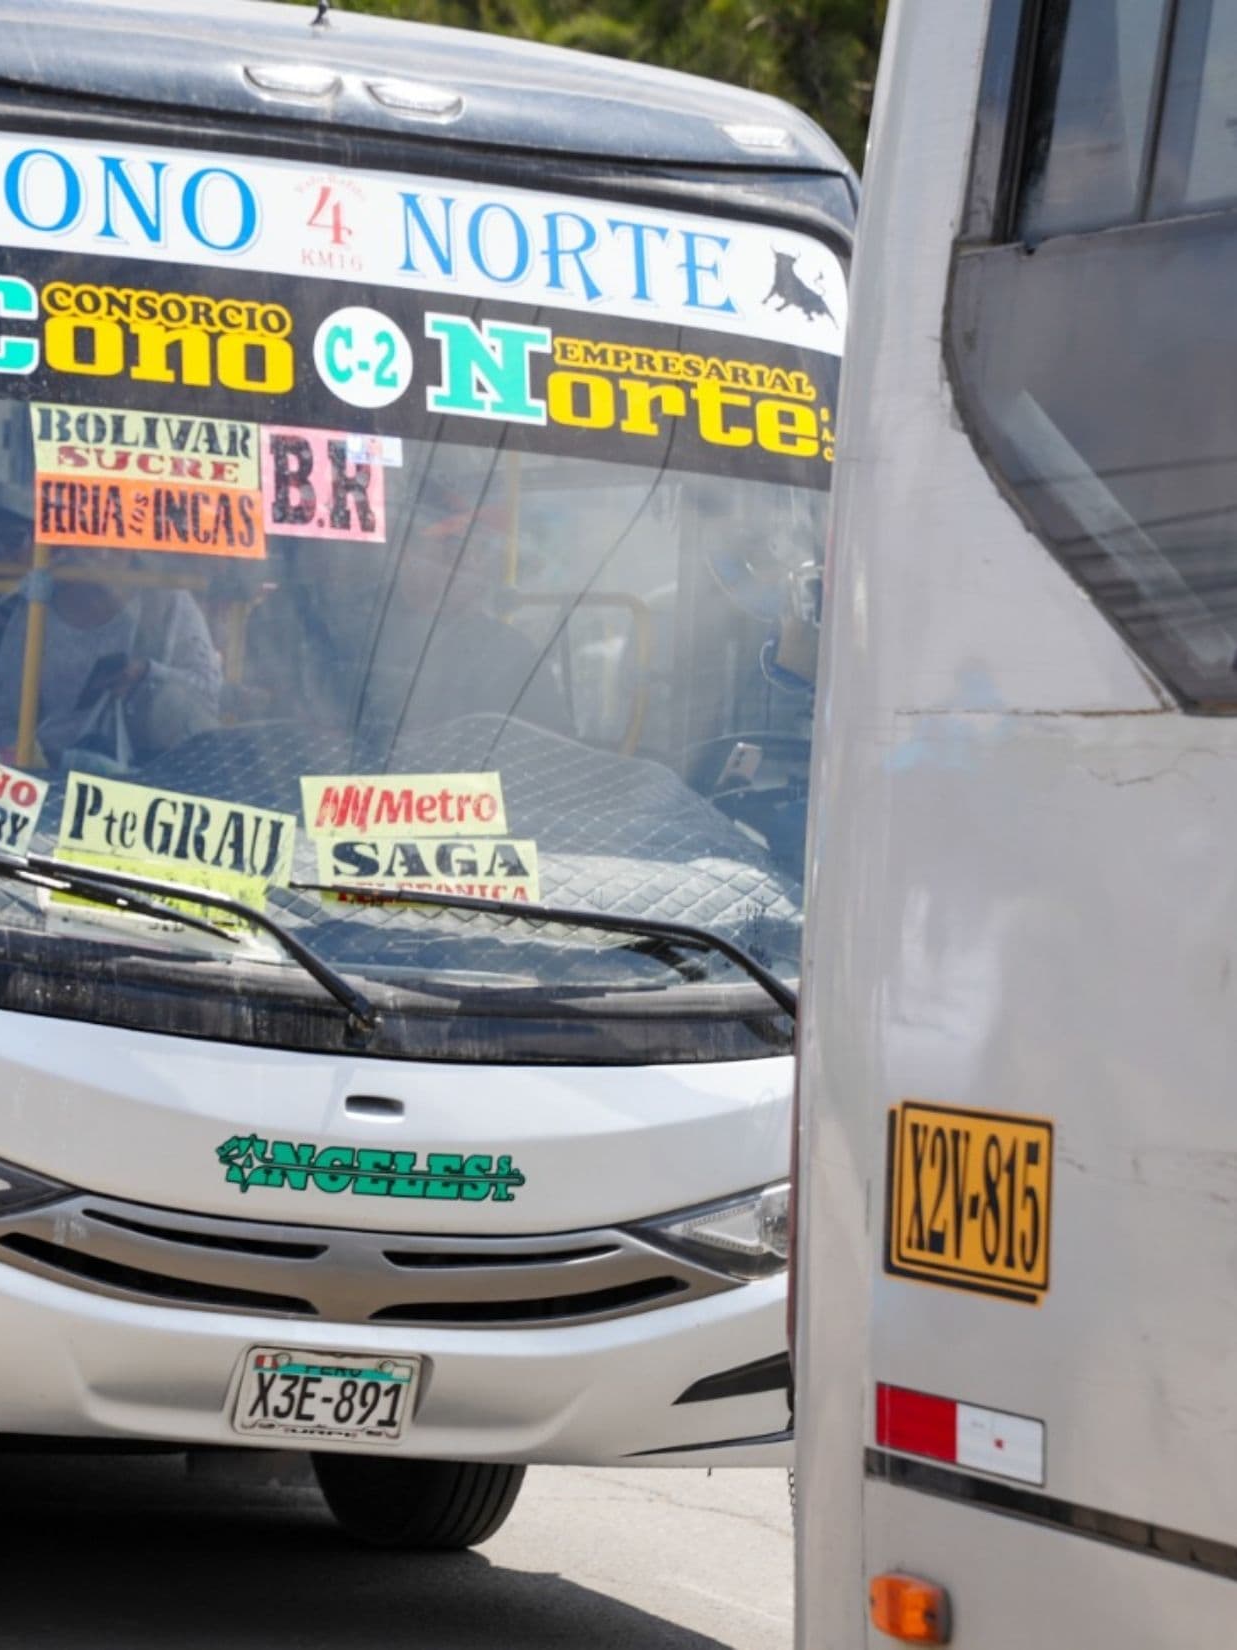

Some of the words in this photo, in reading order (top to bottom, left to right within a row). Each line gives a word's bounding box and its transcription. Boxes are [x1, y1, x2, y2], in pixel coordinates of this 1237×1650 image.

[305, 185, 353, 245] 4
[397, 190, 741, 316] NORTE
[43, 282, 293, 337] CONSORCIO
[324, 323, 399, 389] C-2
[553, 337, 816, 401] EMPRESARIAL
[36, 406, 252, 459] BOLIVAR
[56, 445, 240, 483] SUCRE
[153, 486, 256, 548] INCAS
[374, 787, 497, 825] Metro
[330, 841, 530, 878] SAGA
[906, 1121, 1041, 1274] X2V-815
[248, 1372, 404, 1428] X3E-891
